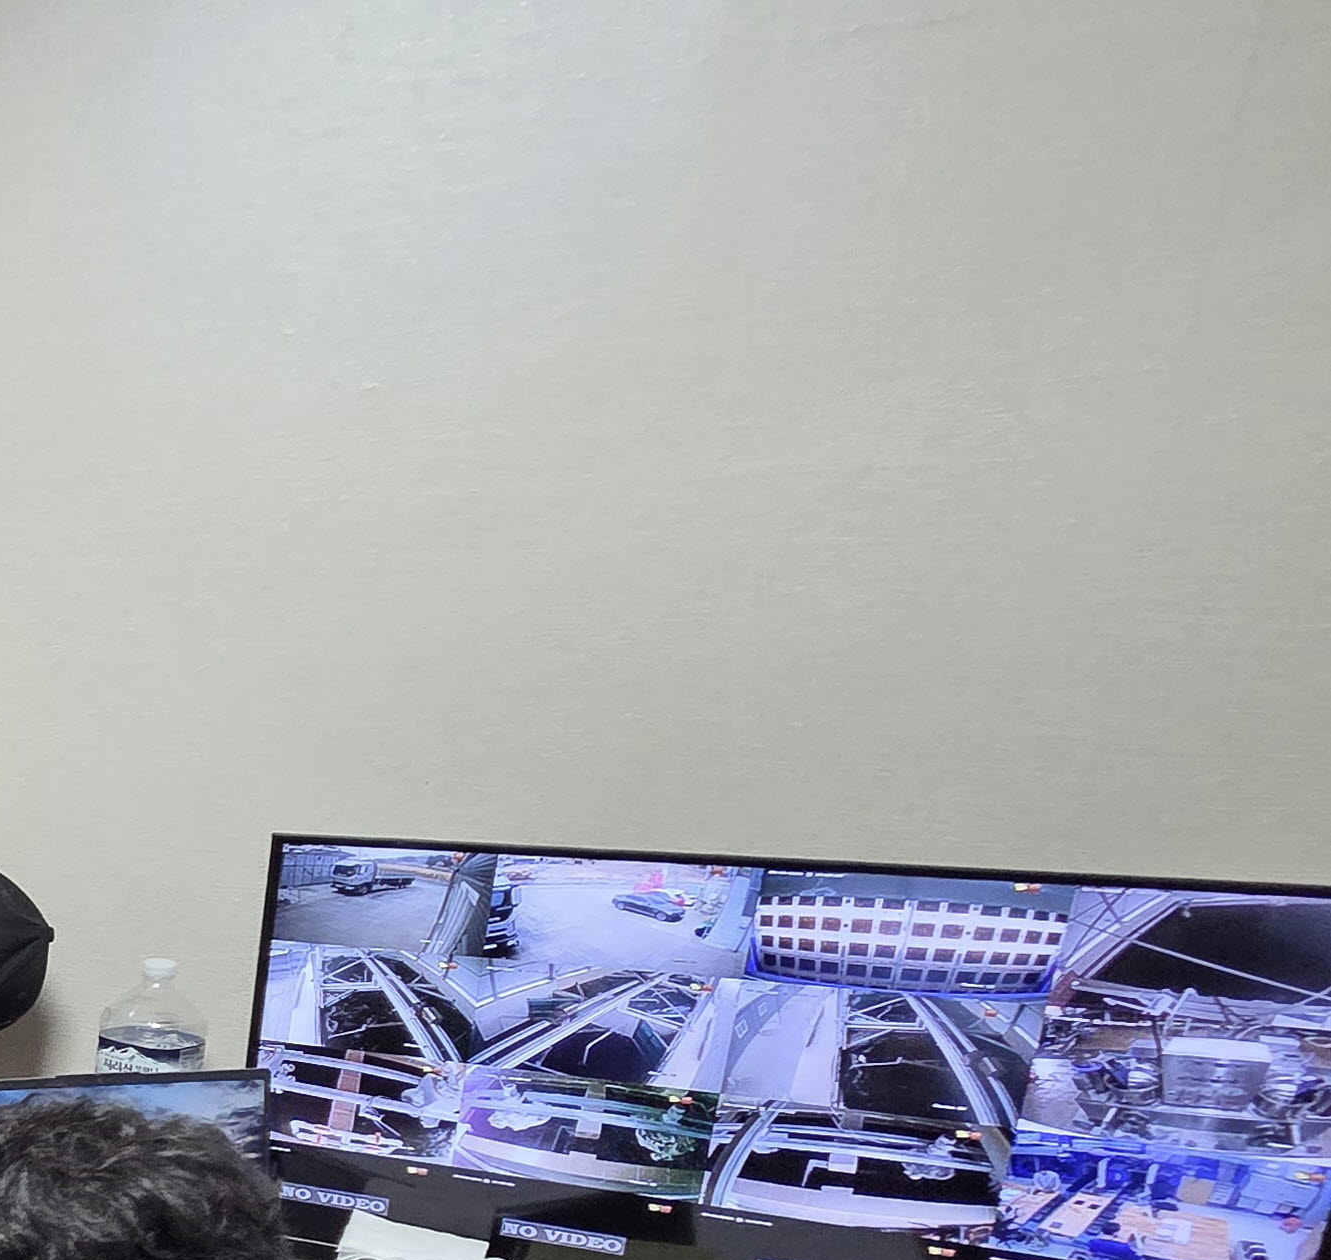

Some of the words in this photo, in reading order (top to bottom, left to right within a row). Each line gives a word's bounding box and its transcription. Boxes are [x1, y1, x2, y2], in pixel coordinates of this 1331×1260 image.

[281, 1185, 312, 1200] NO
[317, 1191, 386, 1213] VIDEO
[503, 1222, 538, 1238] NO
[543, 1228, 622, 1252] VIDEO
